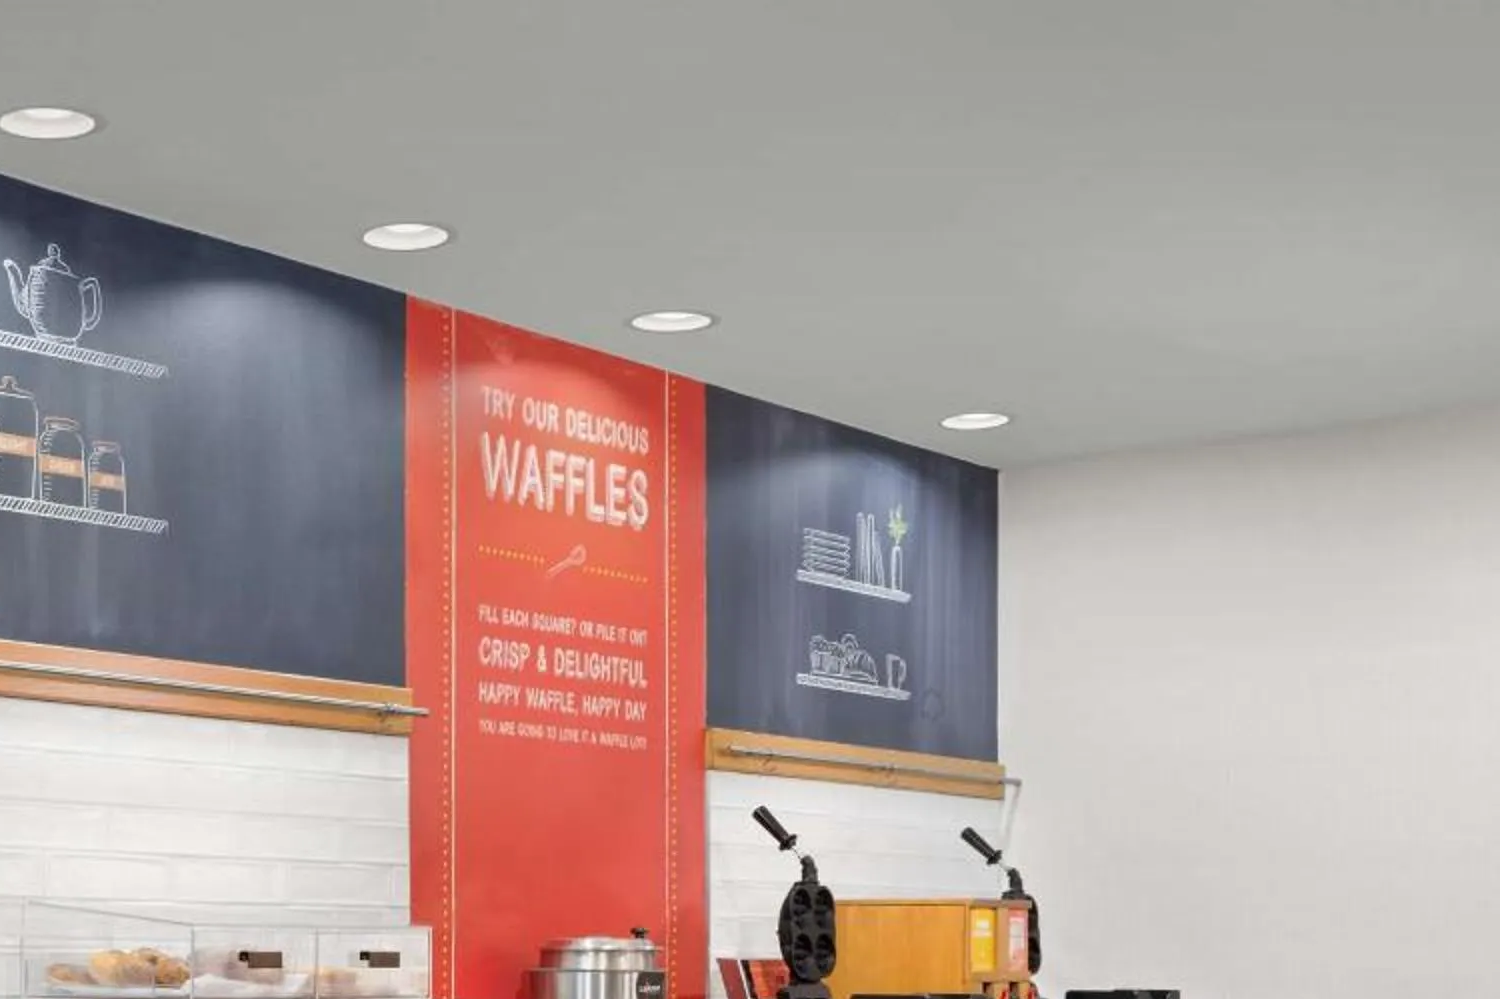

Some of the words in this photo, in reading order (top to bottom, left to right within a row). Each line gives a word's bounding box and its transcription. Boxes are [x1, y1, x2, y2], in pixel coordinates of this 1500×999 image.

[482, 385, 515, 421] TRY
[522, 397, 560, 433] OUR
[565, 407, 649, 456] DELICIOUS
[481, 431, 649, 531] WAFFLES
[478, 604, 499, 625] FILL
[501, 607, 529, 628] EACH
[579, 620, 594, 639] OR
[595, 623, 616, 643] PILE
[478, 636, 531, 672] CRISP
[536, 644, 547, 673] &
[554, 647, 648, 689] DELIGHTFUL
[478, 680, 521, 706] HAPPY
[525, 686, 578, 717] WAFFLE,
[582, 695, 621, 719] HAPPY
[624, 700, 648, 722] DAY
[479, 719, 497, 736] YOU
[498, 721, 516, 737] ARE
